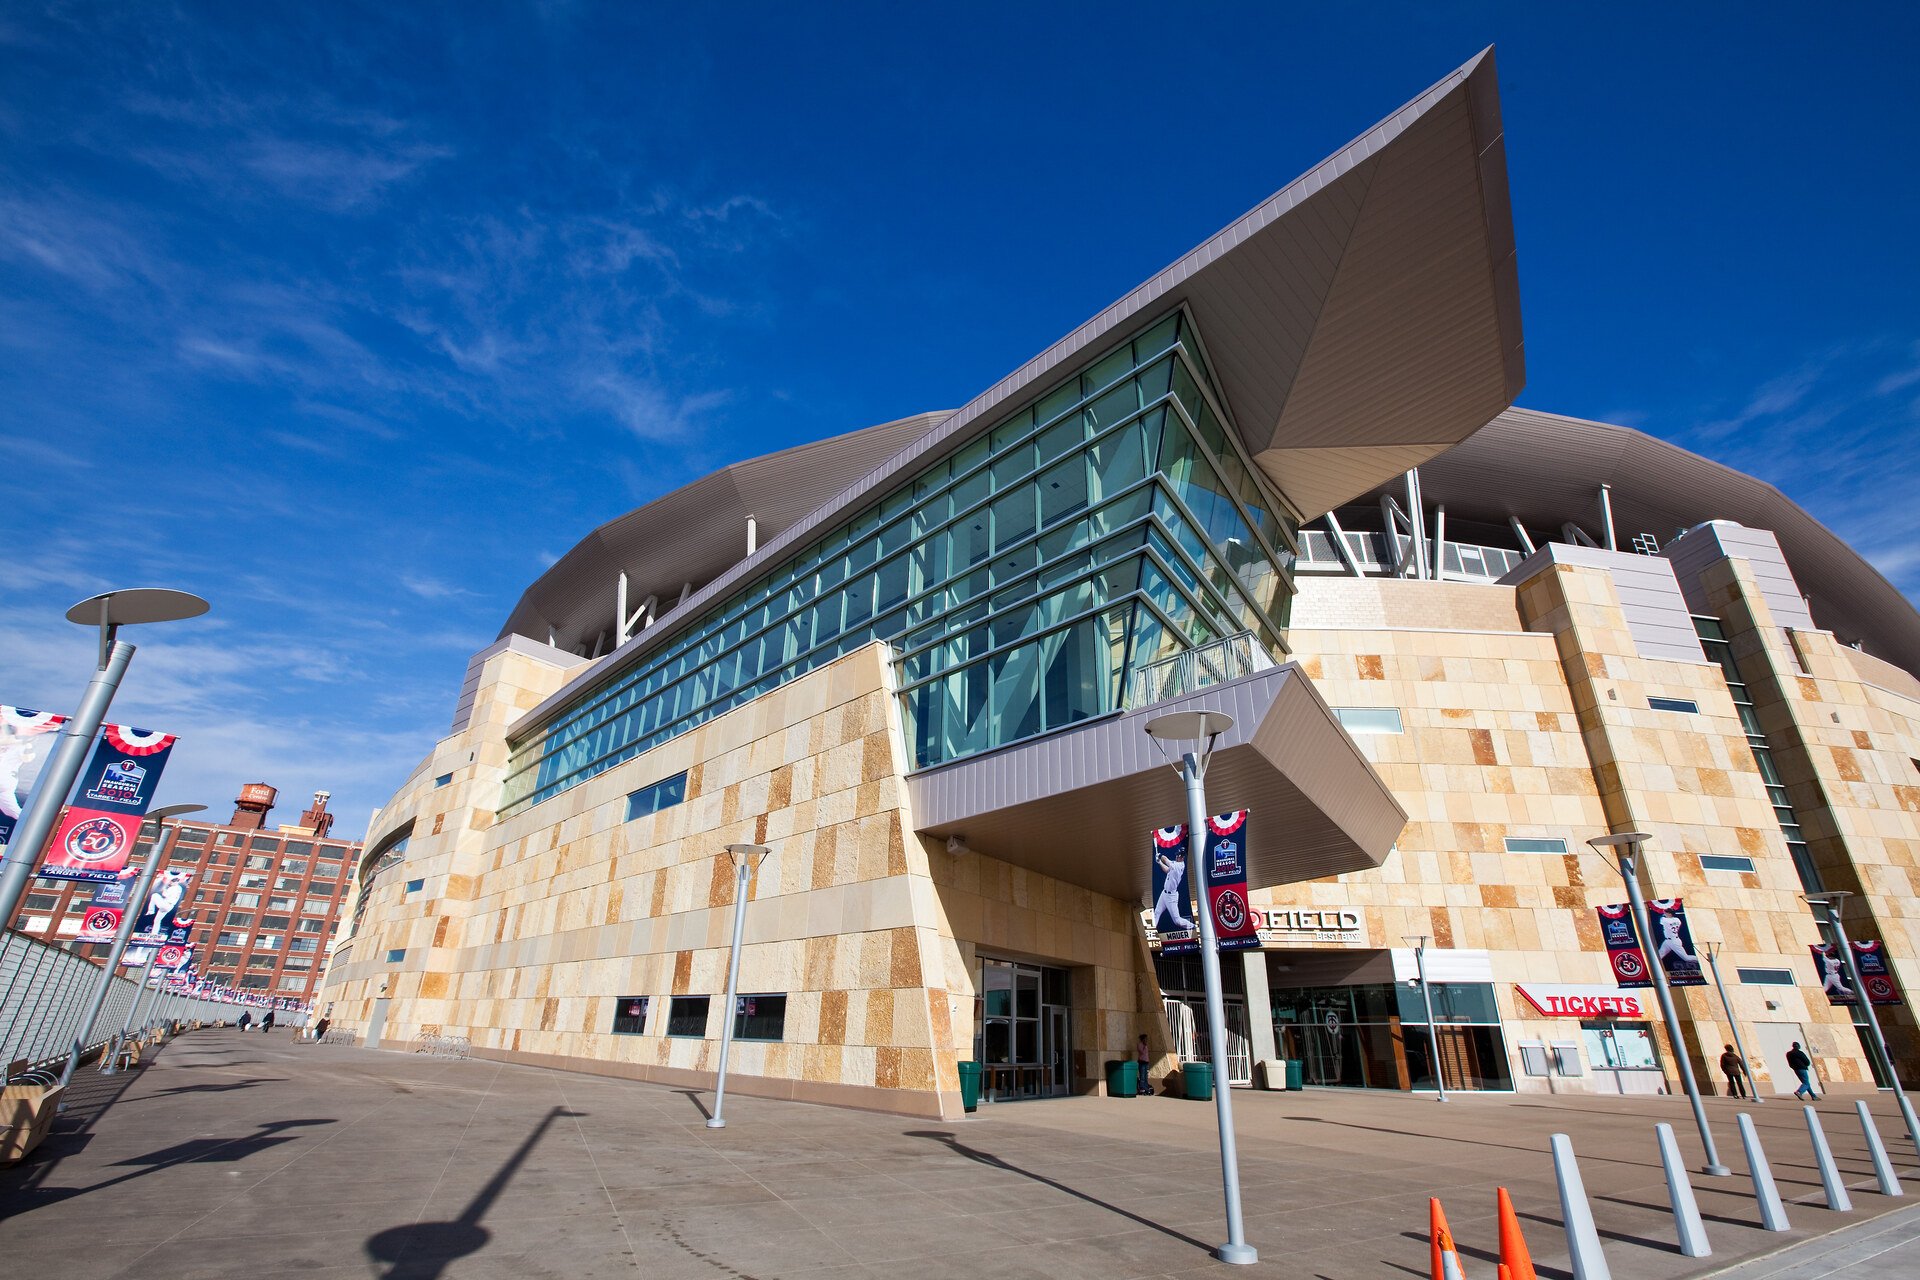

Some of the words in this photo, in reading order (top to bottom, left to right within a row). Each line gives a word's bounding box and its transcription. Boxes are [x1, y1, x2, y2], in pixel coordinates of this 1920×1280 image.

[101, 783, 136, 792] SEASON
[251, 787, 270, 796] Ford
[90, 793, 115, 801] TARGET
[98, 787, 132, 799] 2010
[81, 832, 110, 850] 50
[45, 868, 80, 877] TARGET
[1225, 904, 1238, 919] 50
[94, 918, 109, 927] 50
[1268, 910, 1361, 929] FIELD
[1166, 931, 1190, 941] MAUER
[1622, 960, 1636, 970] 50
[1546, 996, 1640, 1014] TICKETS
[1637, 1030, 1648, 1038] 34
